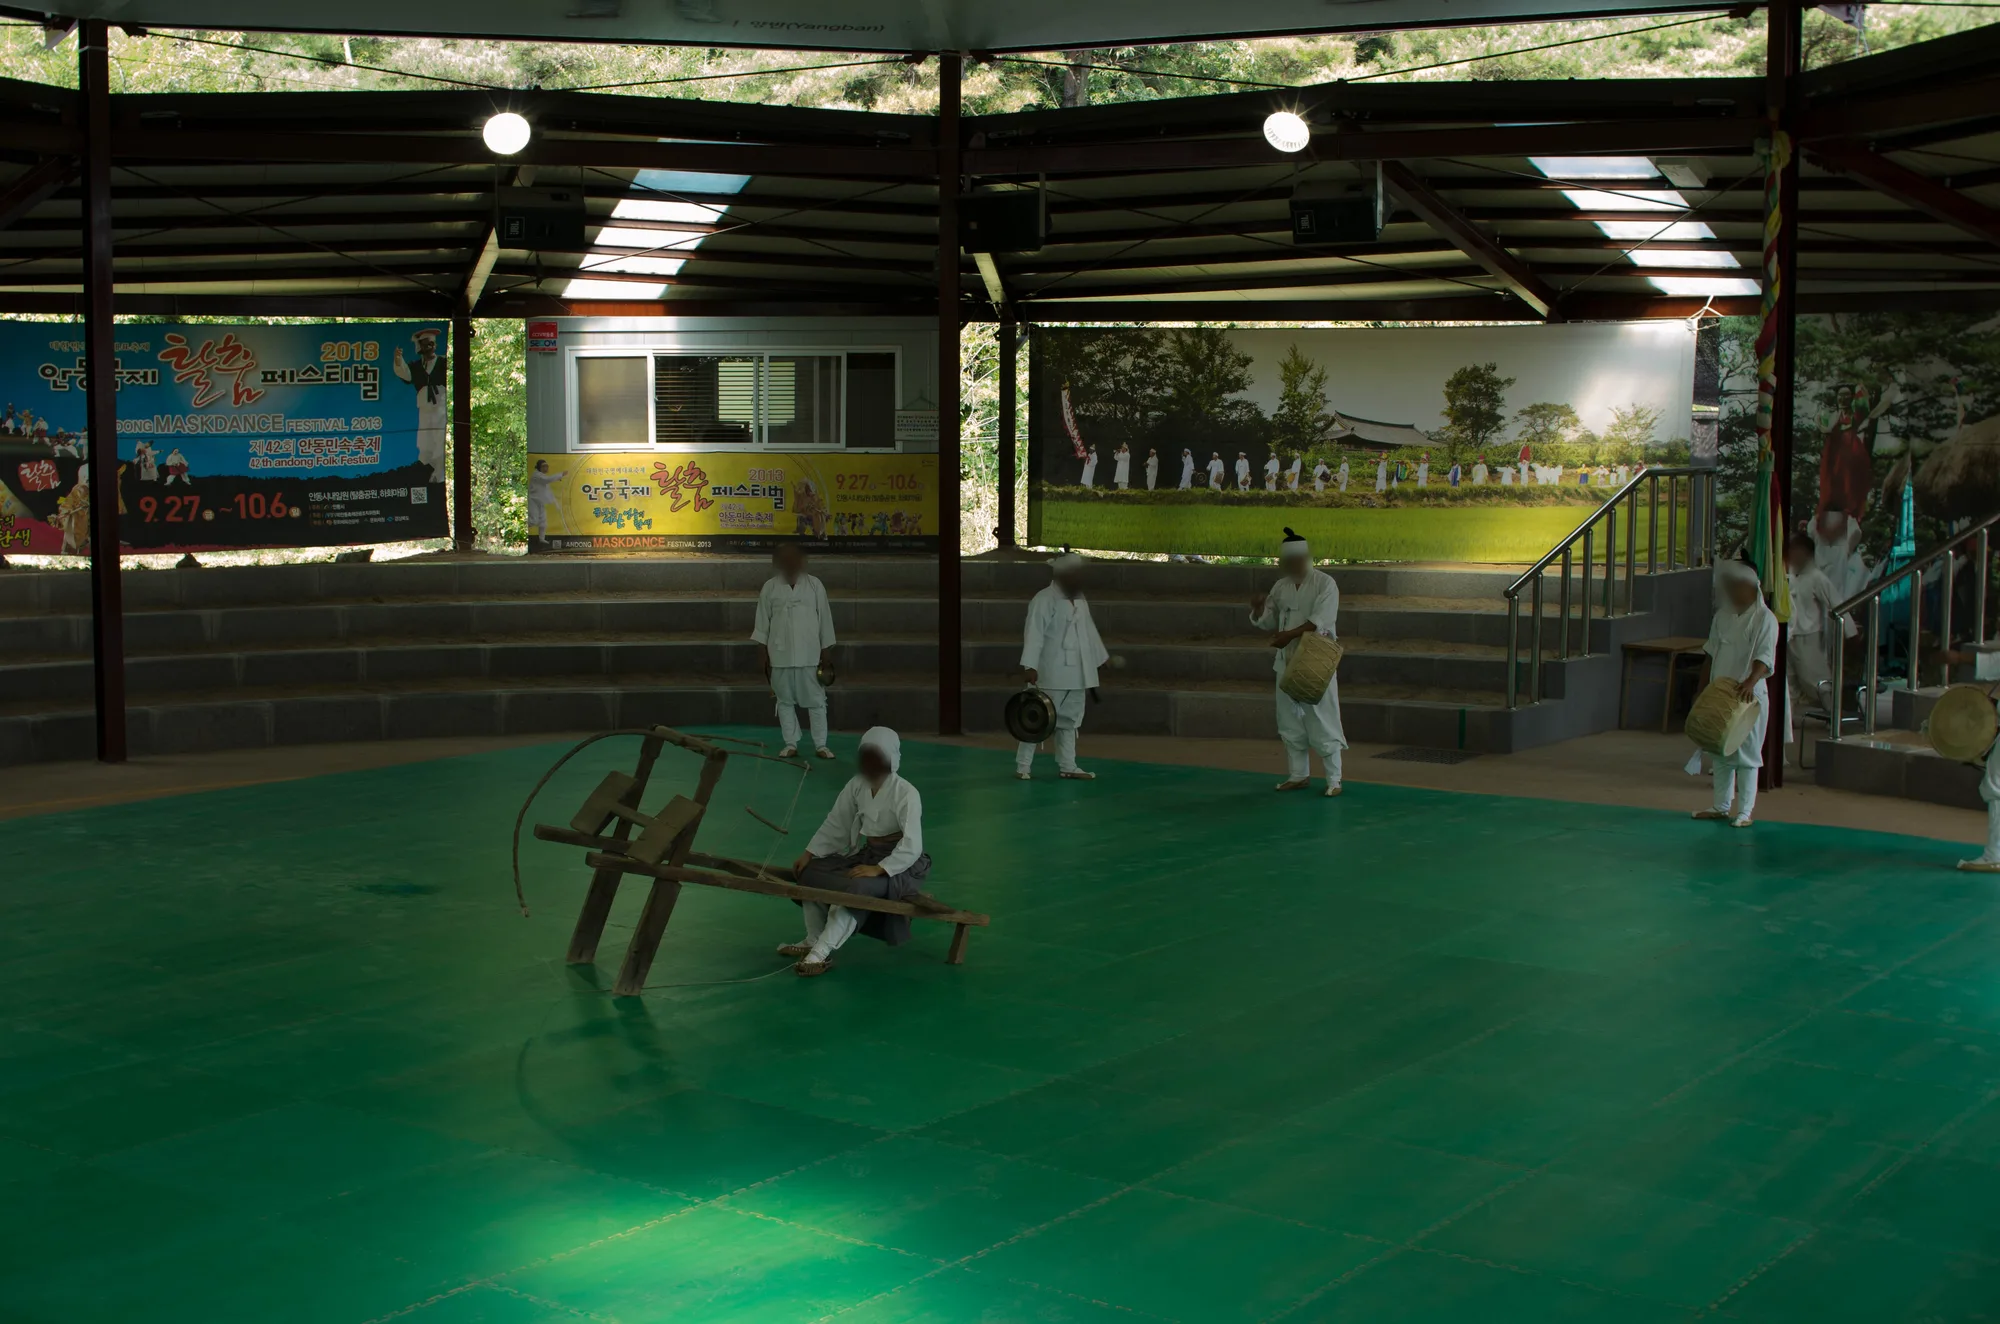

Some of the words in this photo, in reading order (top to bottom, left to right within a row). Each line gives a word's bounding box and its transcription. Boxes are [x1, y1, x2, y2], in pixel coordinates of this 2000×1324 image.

[320, 341, 379, 361] 2013
[158, 333, 264, 408] 탈춤
[260, 364, 380, 401] 페스티벌
[154, 414, 283, 434] MASKDANCE
[286, 420, 348, 432] FESTIVAL
[351, 417, 382, 429] 2013
[249, 440, 296, 455] 제42회
[298, 436, 382, 455] 안동민속축제
[249, 456, 272, 468] 42th
[273, 454, 314, 469] andong
[315, 453, 338, 467] Folk
[340, 449, 379, 465] Festival
[748, 469, 784, 482] 2013
[581, 479, 651, 502] 안동국제
[650, 461, 714, 512] 탈춤
[711, 484, 784, 511] 페스티벌
[718, 511, 773, 523] 안동민속축제
[592, 537, 665, 548] MASKDANCE
